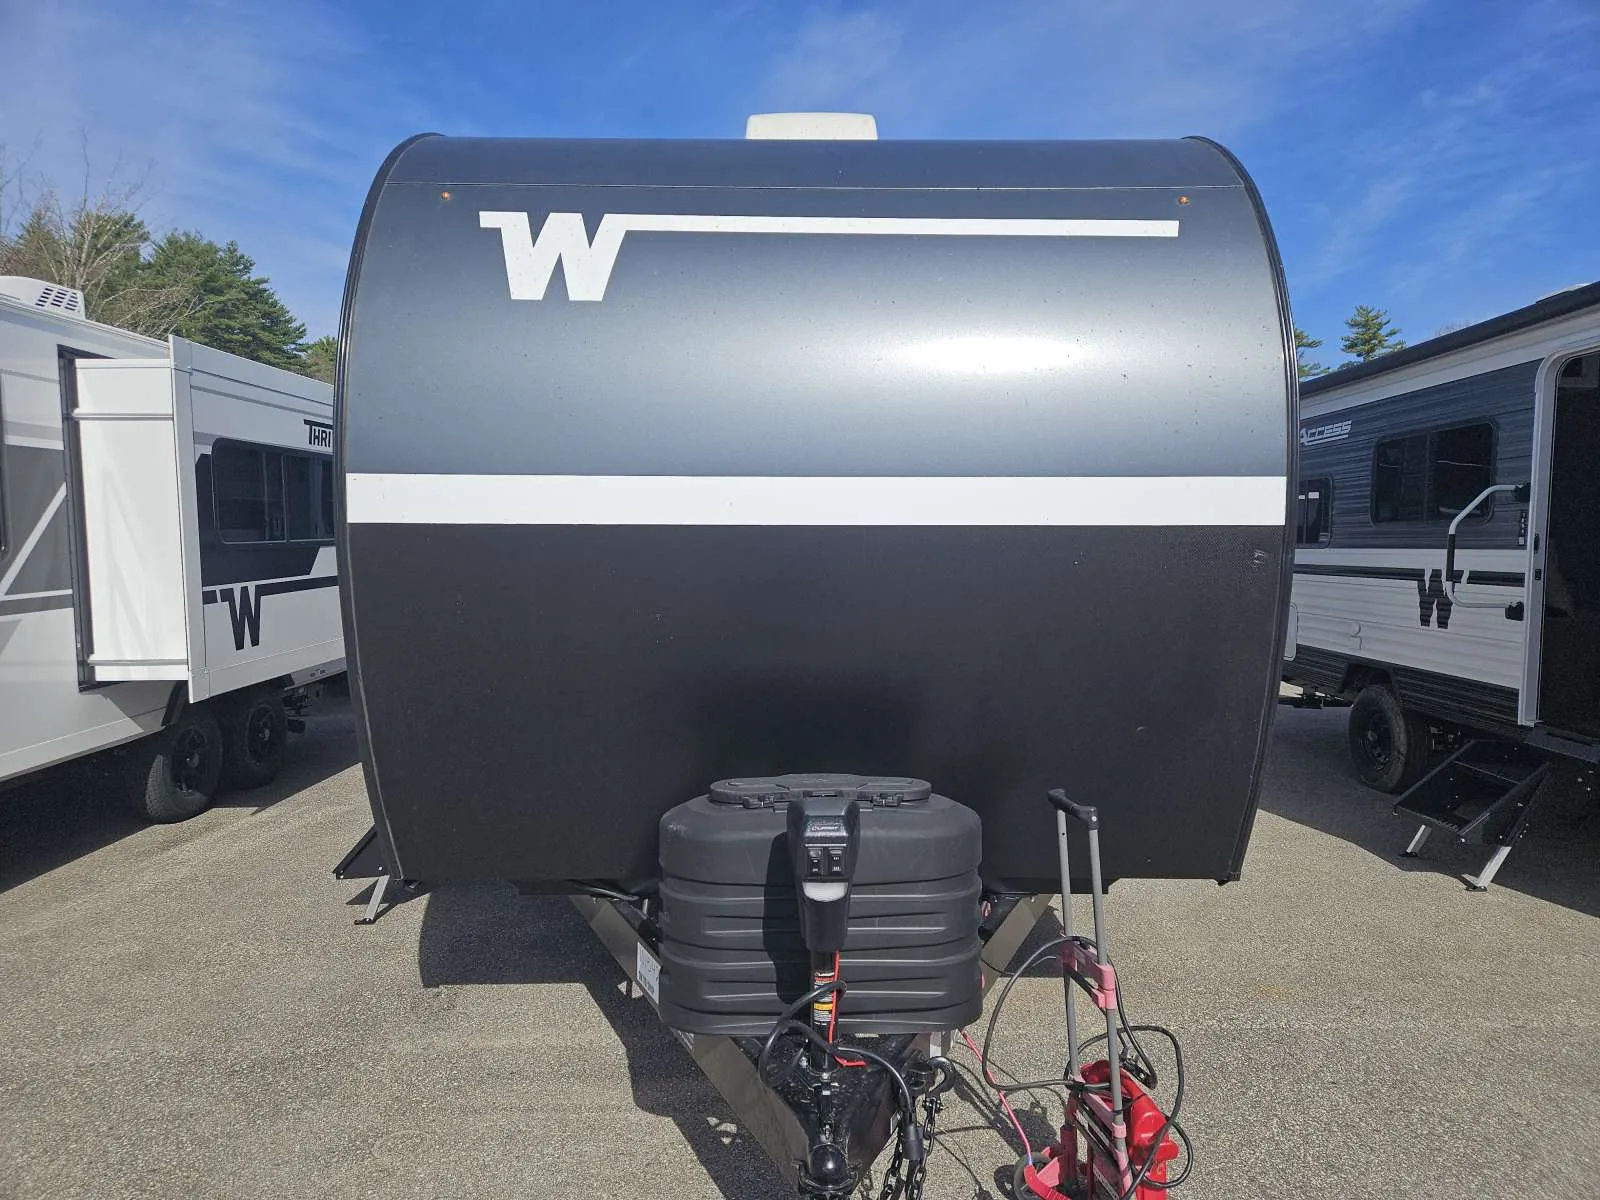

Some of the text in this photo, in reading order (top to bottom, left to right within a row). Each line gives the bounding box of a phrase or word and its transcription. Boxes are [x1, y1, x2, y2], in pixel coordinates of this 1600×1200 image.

[479, 211, 628, 301] W
[303, 419, 333, 448] THRI
[1300, 420, 1352, 446] ACCESS
[218, 584, 262, 651] W
[1416, 568, 1464, 629] W
